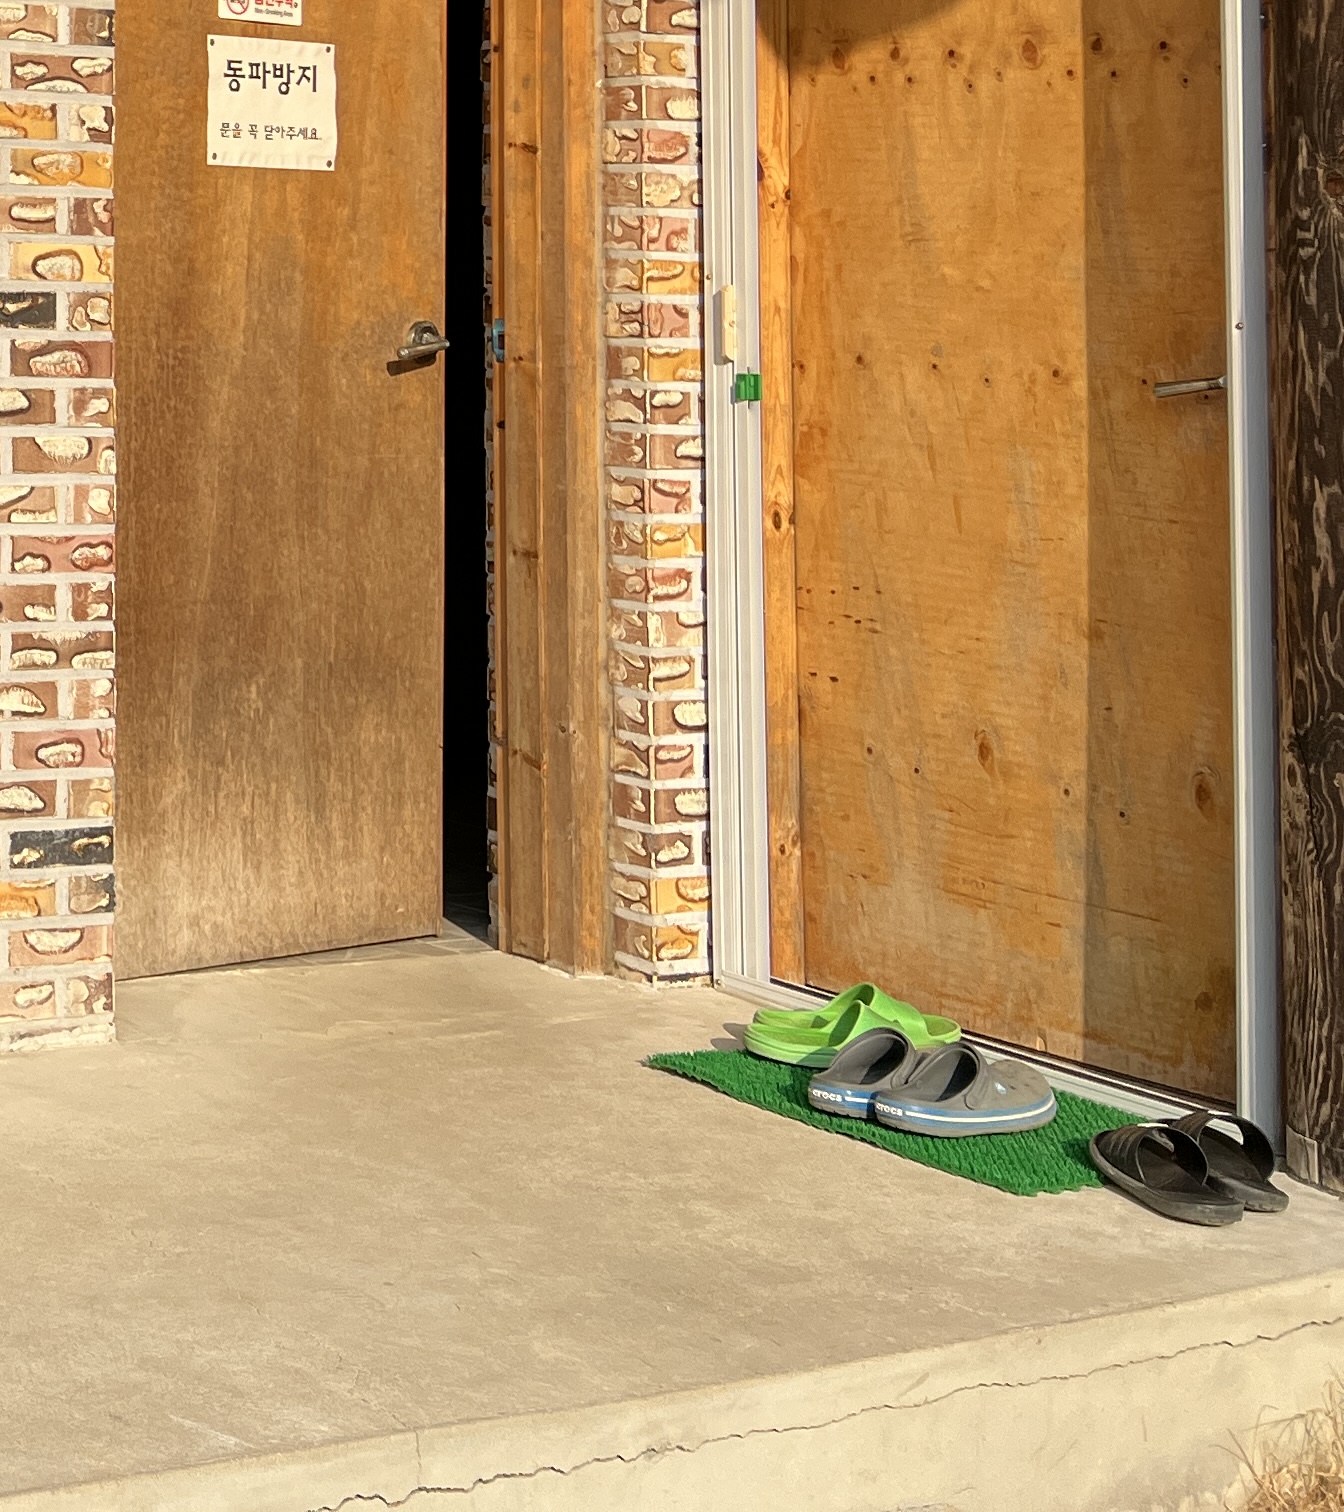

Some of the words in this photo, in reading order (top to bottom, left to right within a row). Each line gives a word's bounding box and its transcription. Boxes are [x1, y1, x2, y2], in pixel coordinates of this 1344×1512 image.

[223, 58, 318, 96] 동파방지
[219, 122, 243, 139] 문을
[248, 123, 259, 140] 꼭
[812, 1089, 843, 1102] crocs
[876, 1102, 903, 1117] crocs
